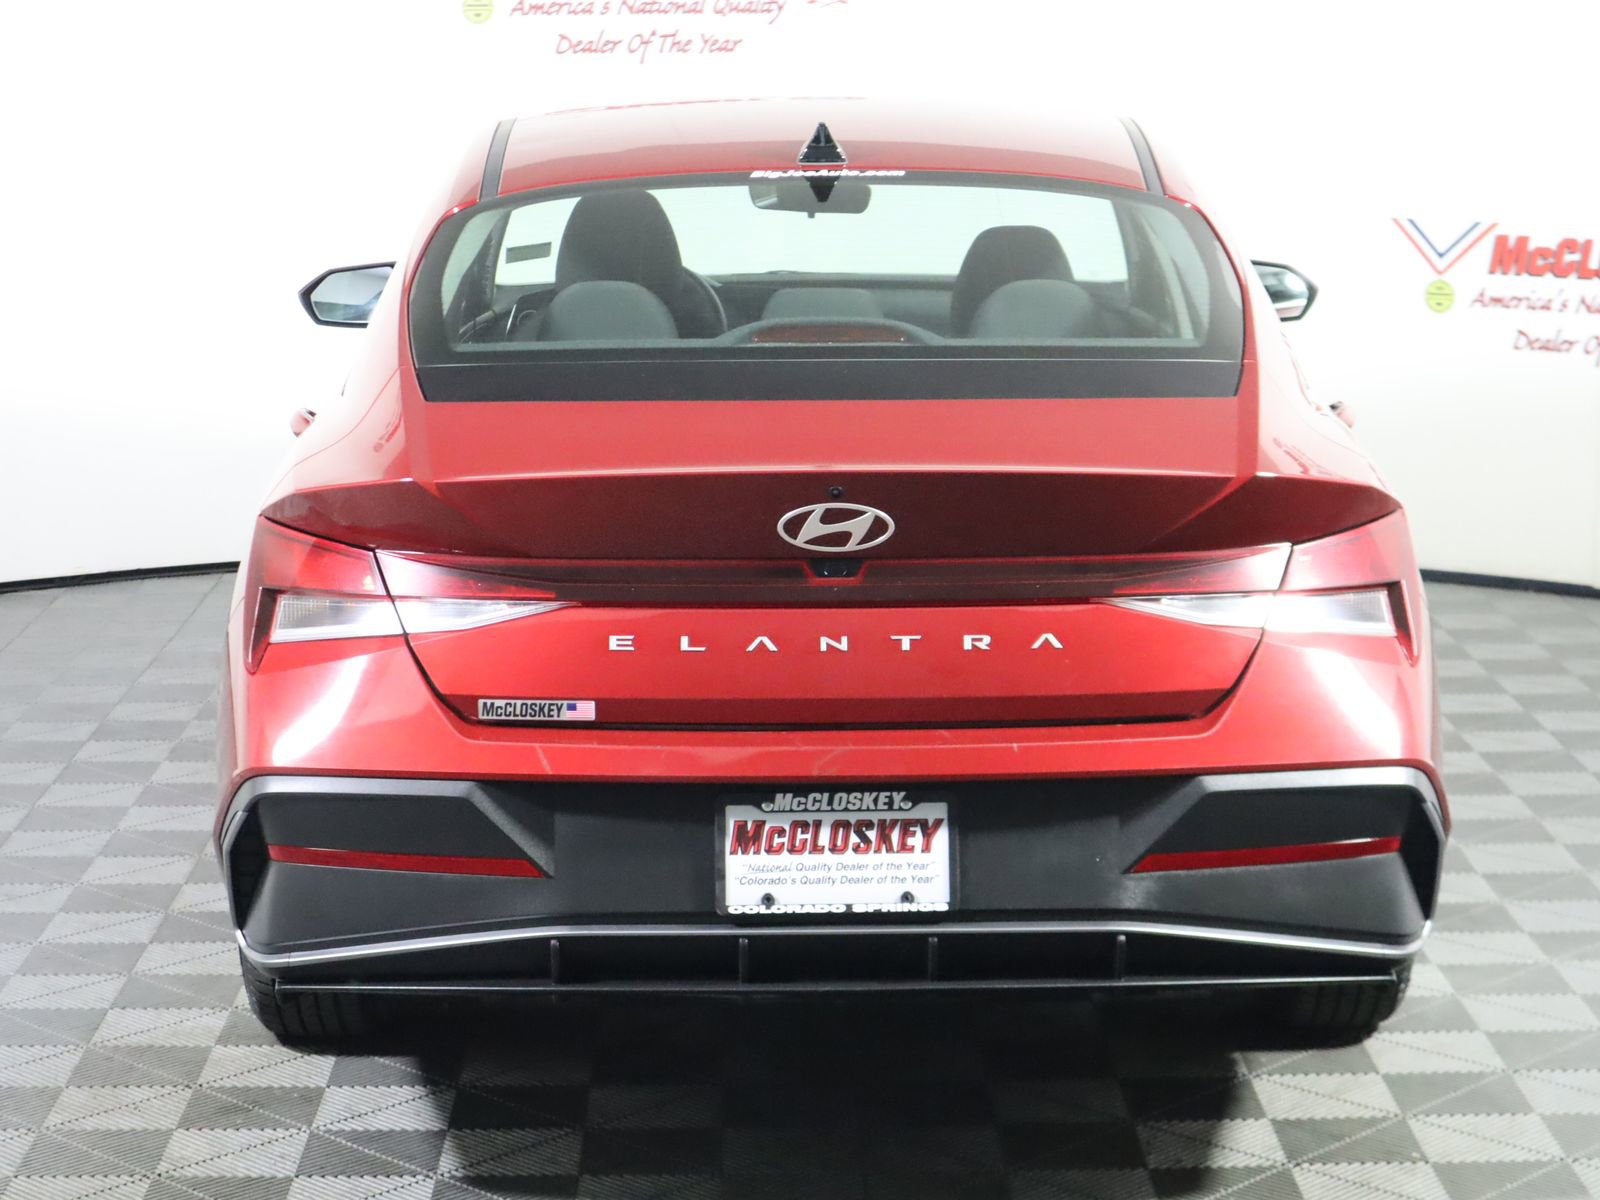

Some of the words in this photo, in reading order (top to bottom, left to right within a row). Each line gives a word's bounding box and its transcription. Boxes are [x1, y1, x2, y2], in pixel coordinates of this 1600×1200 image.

[509, 0, 611, 16] Americas
[617, 0, 705, 14] National
[712, 0, 786, 25] Quality
[555, 30, 622, 54] Dealer
[627, 30, 657, 64] Of
[659, 30, 694, 53] The
[698, 34, 743, 54] Year
[1489, 234, 1600, 280] McCL
[1470, 288, 1569, 313] America's
[1513, 329, 1579, 353] Dealer
[608, 632, 1064, 652] ELANTRA
[481, 701, 564, 718] McCLOSKEY
[773, 791, 906, 811] McCLOSKEY
[729, 817, 945, 856] McCLOSKEY
[795, 862, 833, 873] Quality
[835, 861, 869, 872] Dealer
[872, 861, 884, 871] of
[886, 861, 903, 871] the
[799, 875, 838, 887] Quality
[840, 875, 874, 885] Dealer
[876, 875, 888, 885] of
[890, 874, 908, 885] the
[727, 903, 847, 914] COLORADO
[851, 902, 949, 913] SPRINGS
